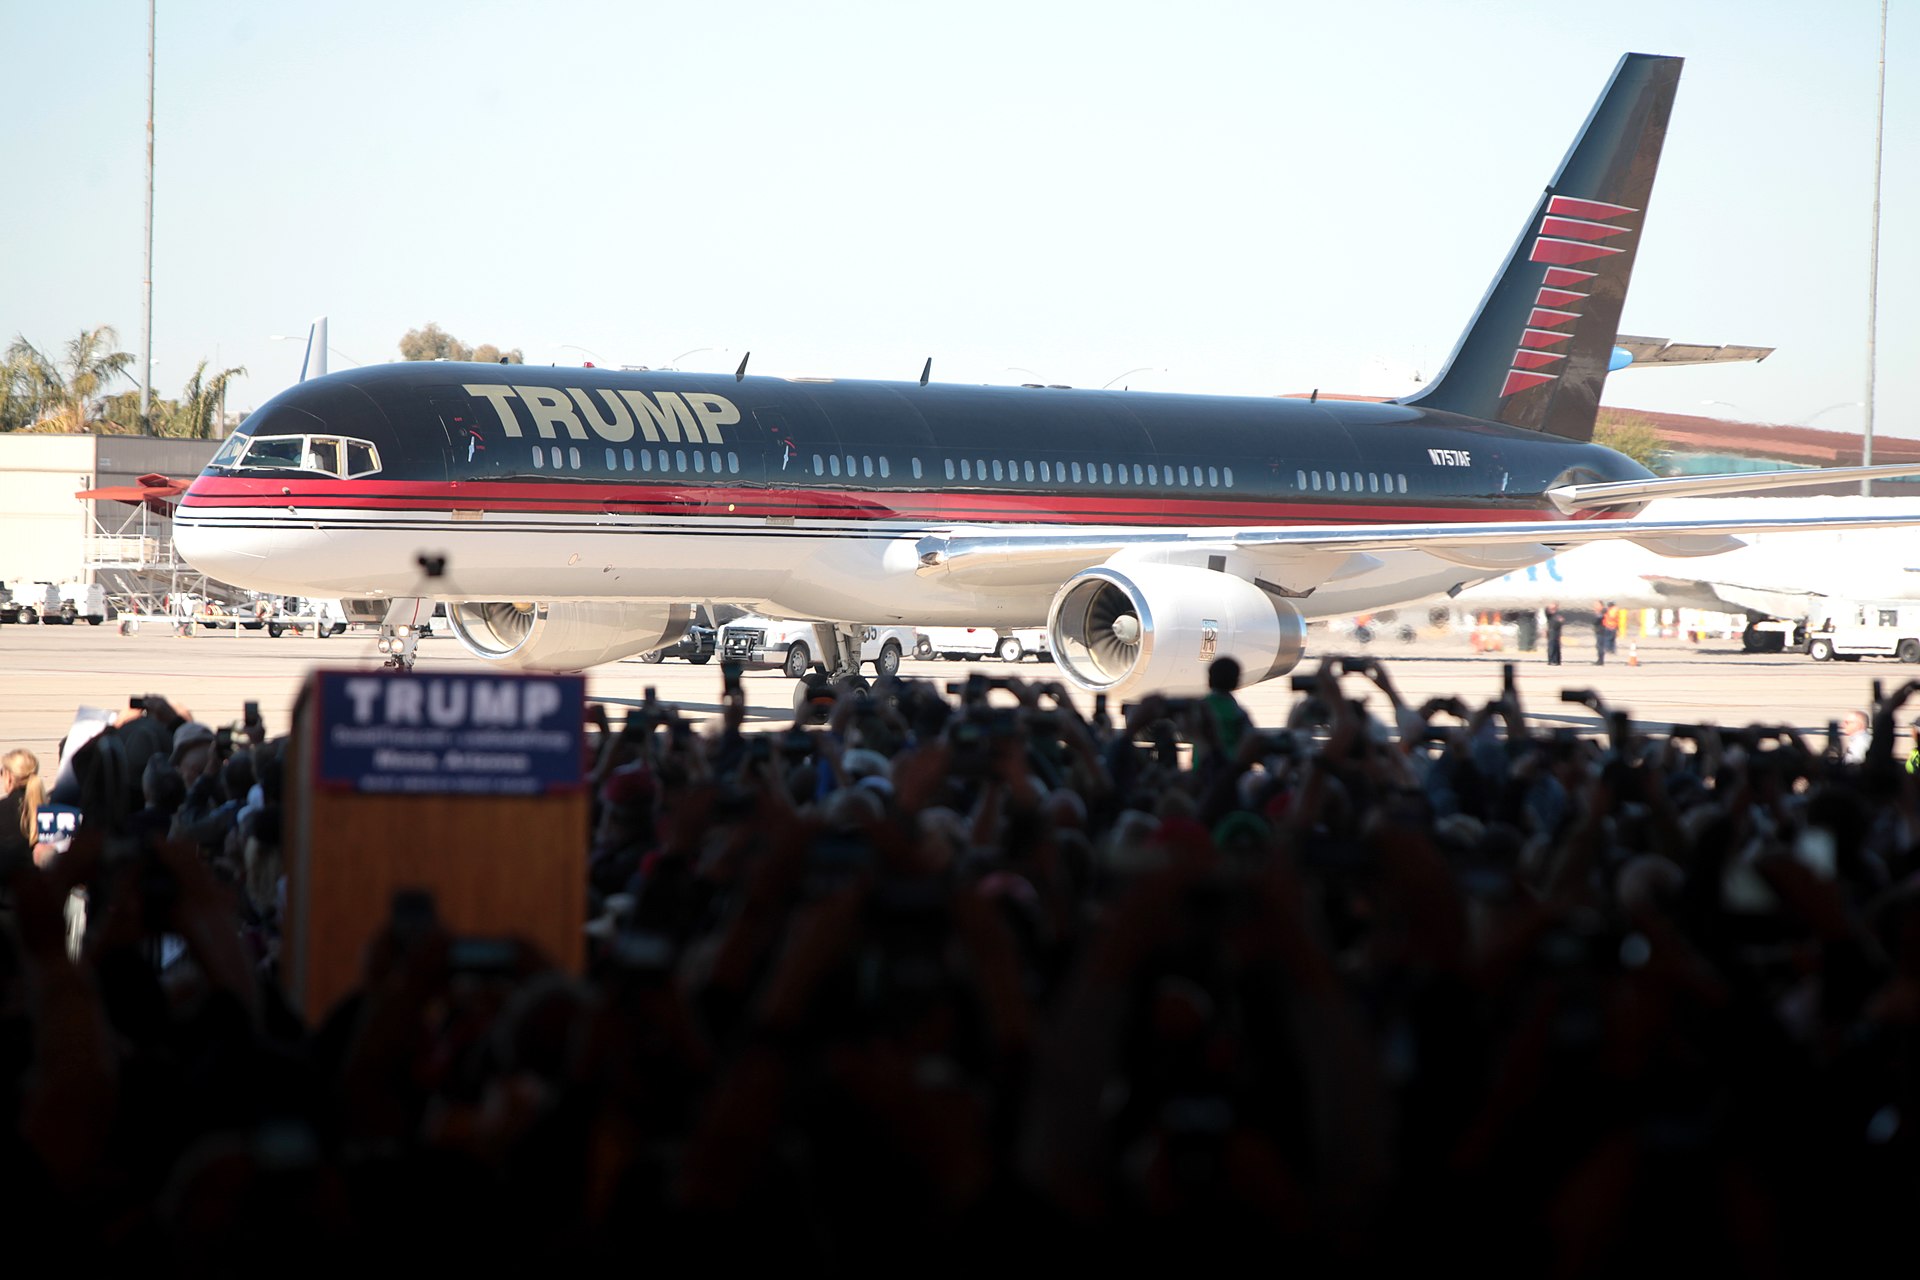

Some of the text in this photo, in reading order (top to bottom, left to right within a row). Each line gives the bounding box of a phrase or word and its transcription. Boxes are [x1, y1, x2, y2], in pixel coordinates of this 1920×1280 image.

[462, 384, 741, 444] TRUMP
[1427, 448, 1471, 467] N757AF
[345, 679, 562, 726] TRUMP
[38, 812, 83, 831] TR
